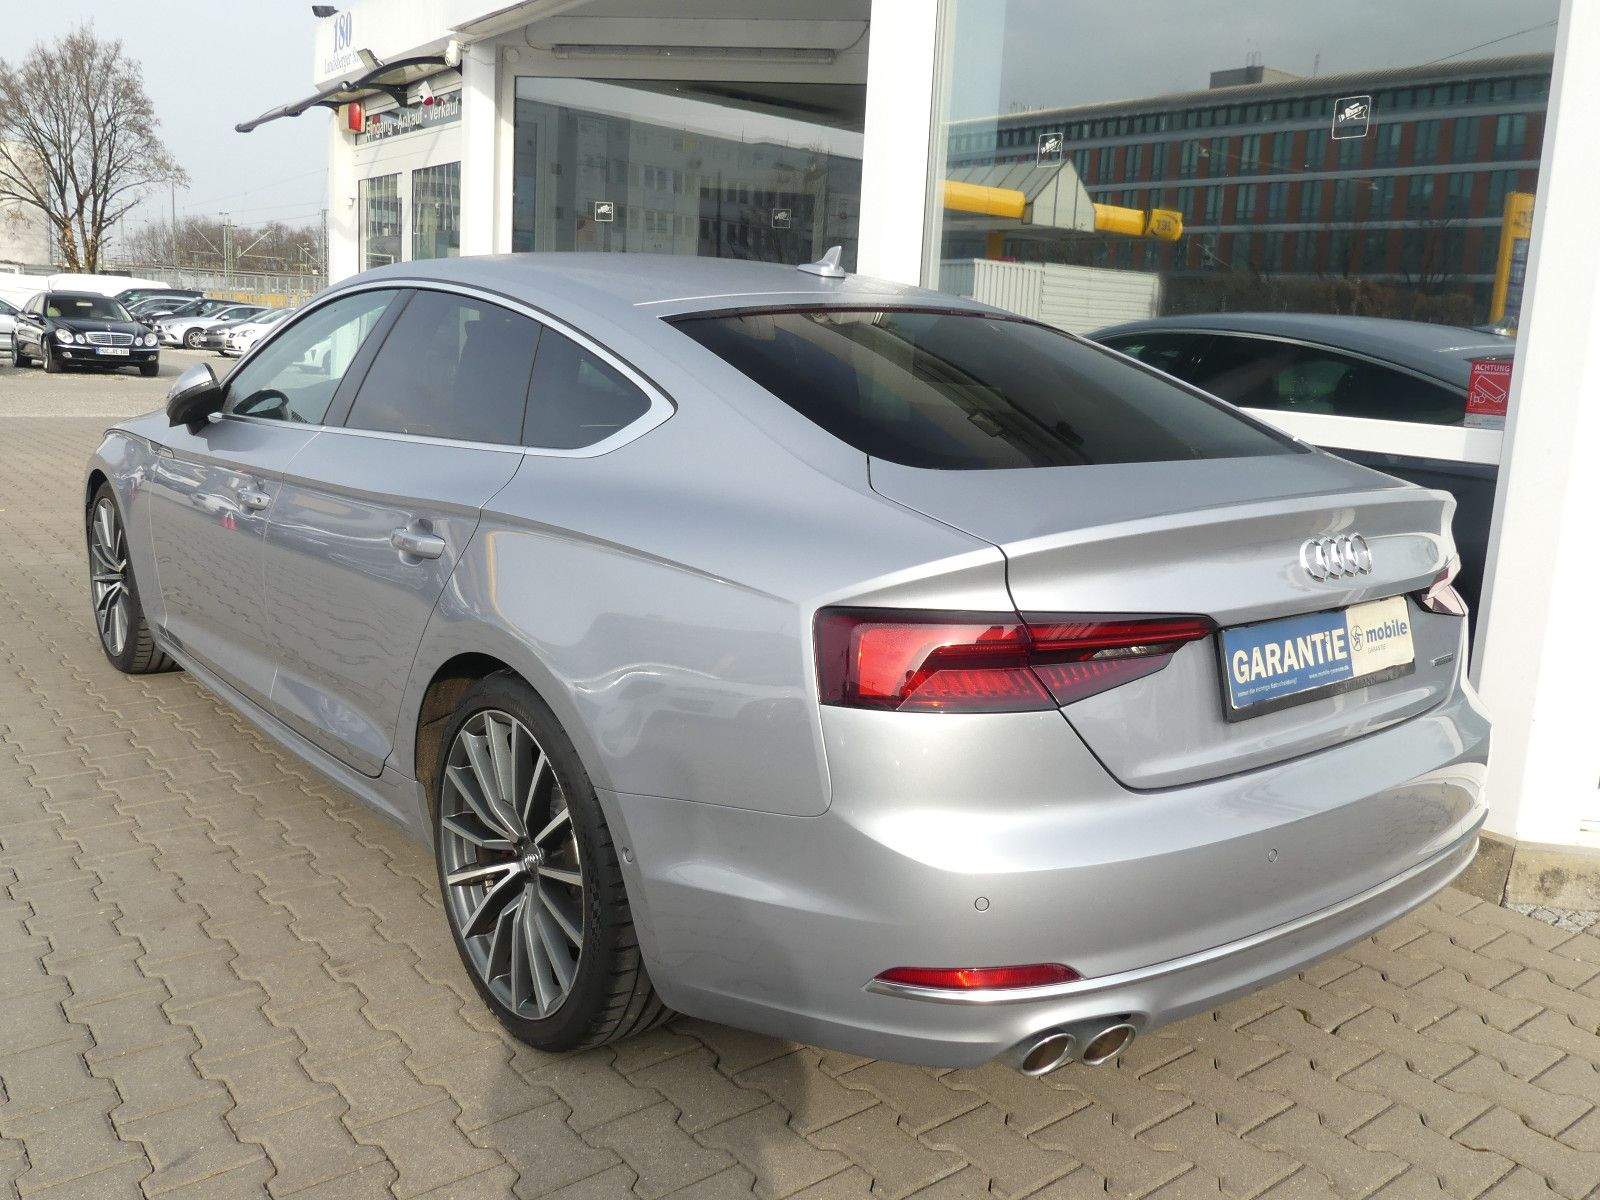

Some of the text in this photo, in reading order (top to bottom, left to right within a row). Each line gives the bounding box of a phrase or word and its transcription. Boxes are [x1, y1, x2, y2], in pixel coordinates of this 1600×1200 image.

[333, 11, 352, 52] 180
[429, 97, 459, 120] Verkauf
[1232, 618, 1408, 684] GARANTIE mobile
